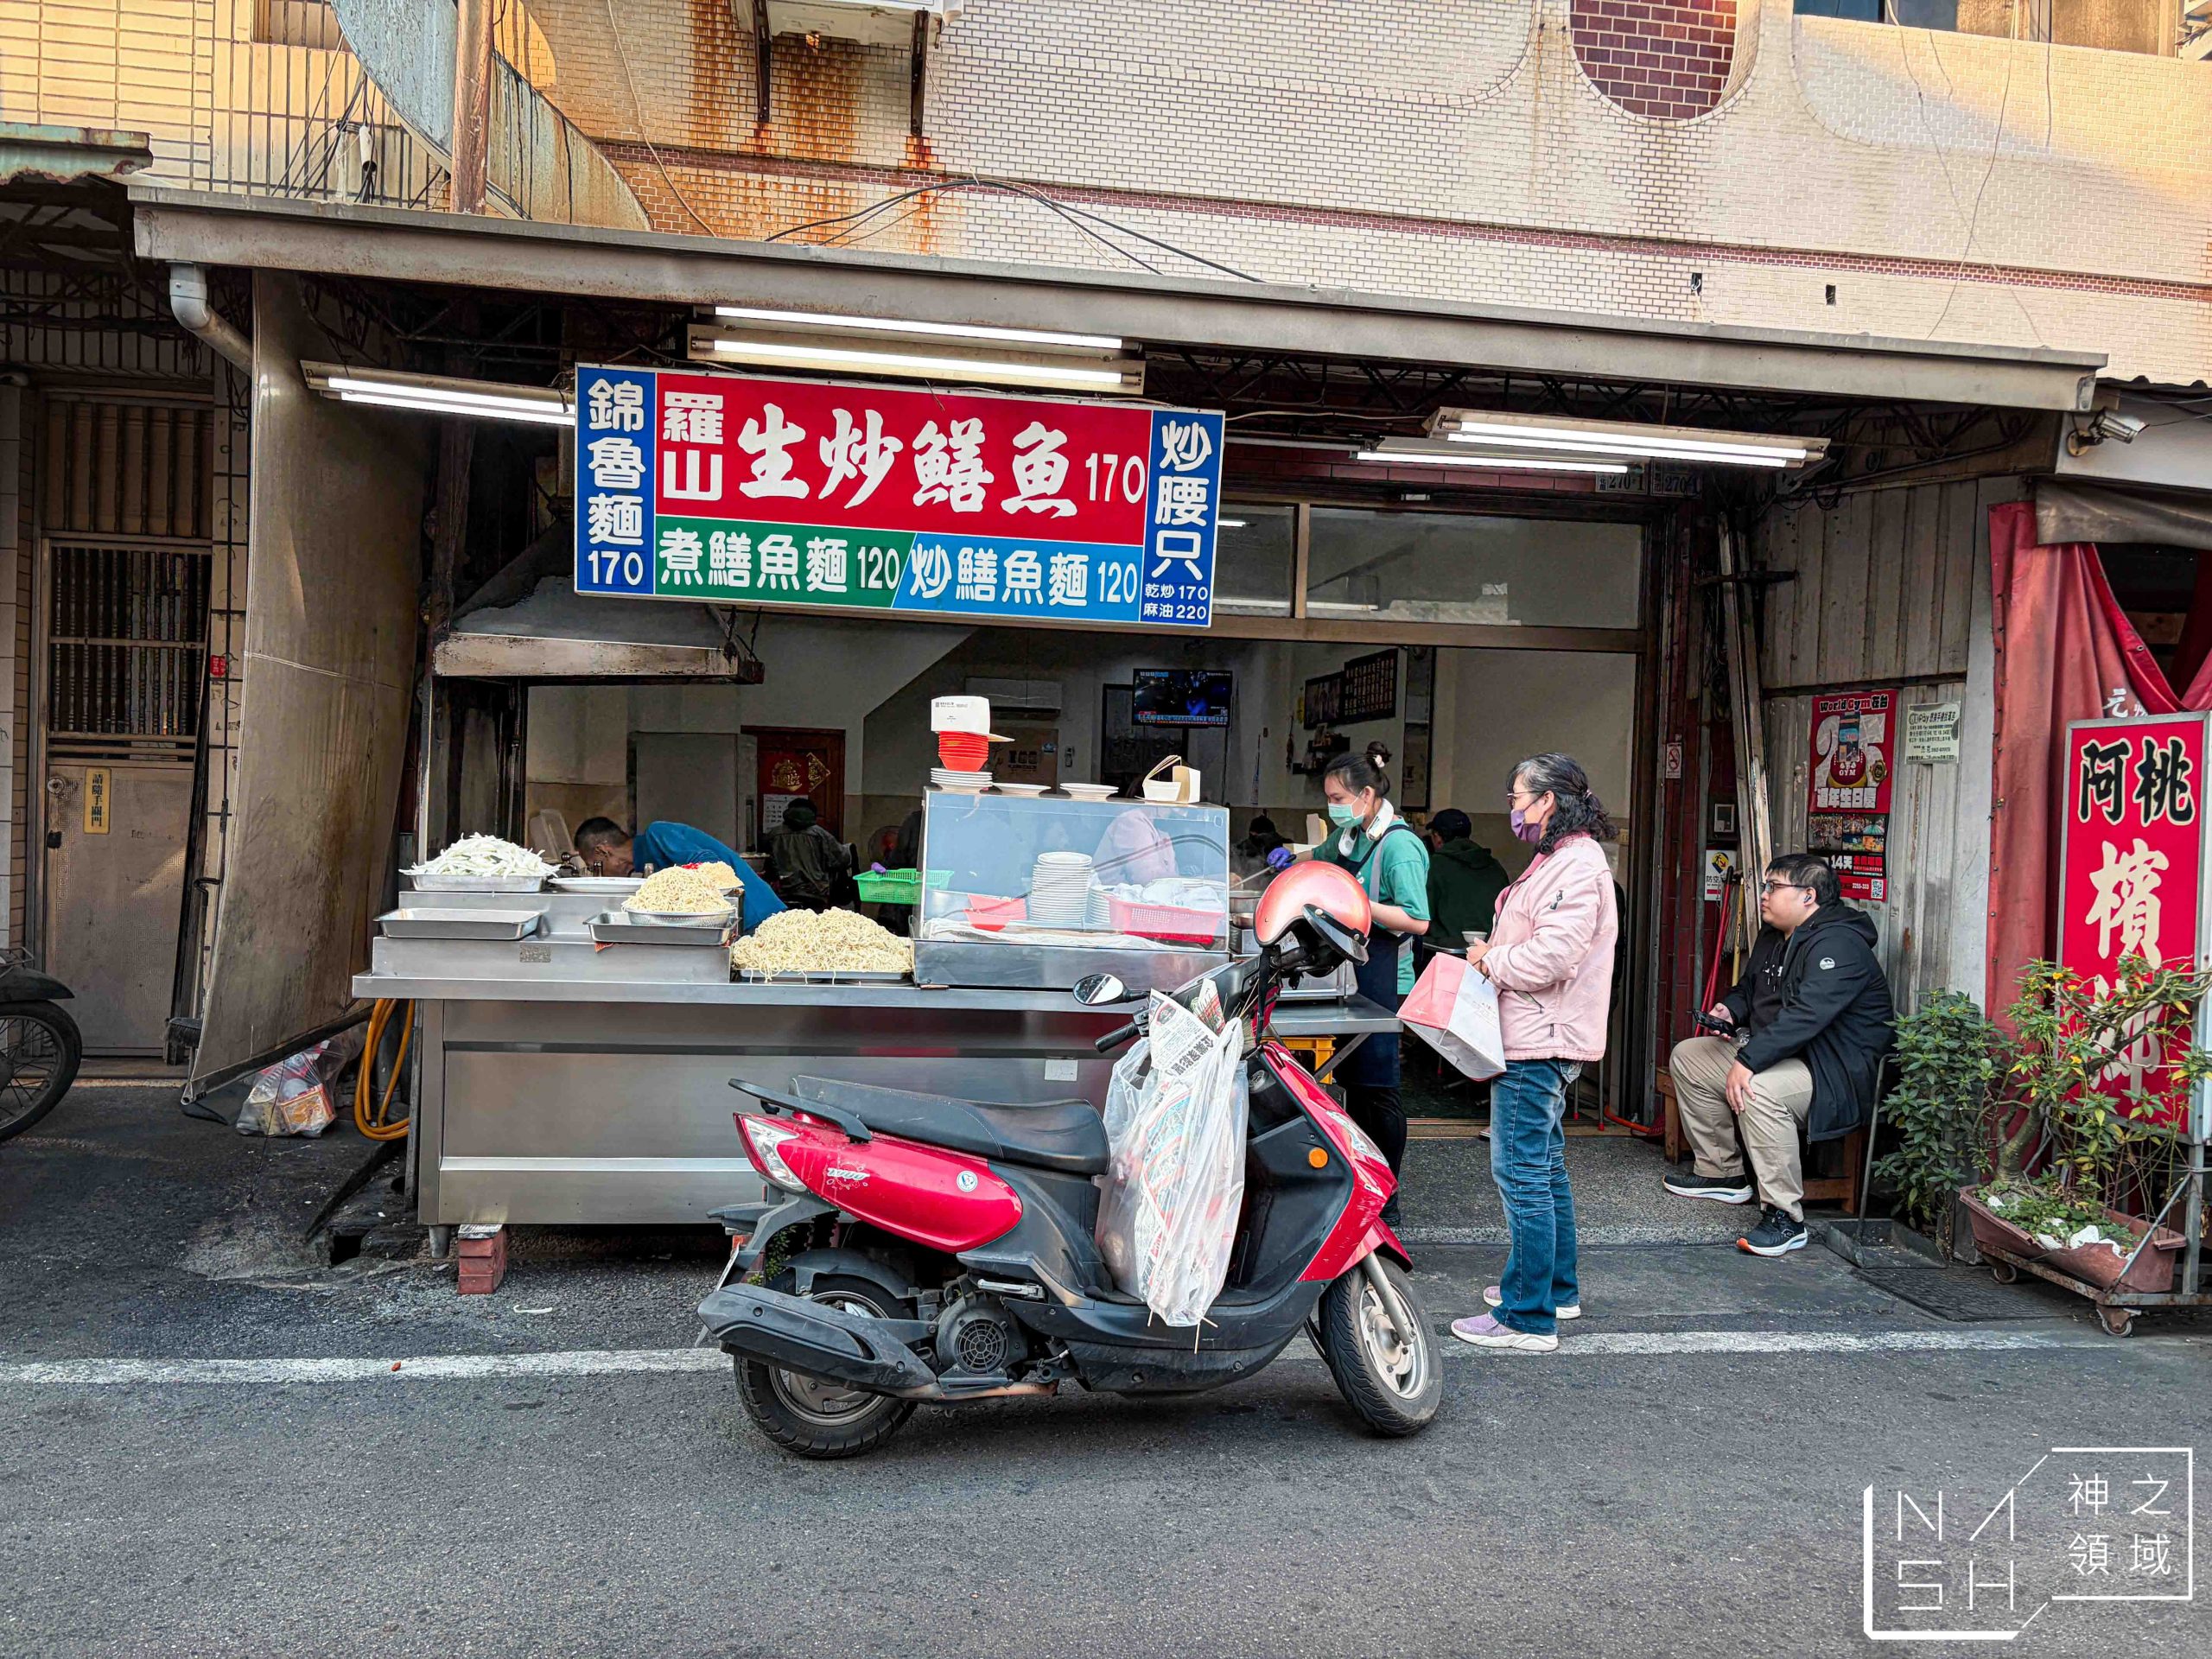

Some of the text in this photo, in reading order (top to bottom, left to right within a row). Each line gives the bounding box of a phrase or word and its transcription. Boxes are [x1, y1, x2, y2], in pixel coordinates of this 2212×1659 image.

[588, 378, 646, 545] 錦魯麵
[662, 391, 724, 501] 羅山
[737, 402, 1146, 519] 生炒鱔魚 170
[1151, 420, 1212, 581] 炒腰只
[588, 550, 644, 586] 170
[659, 526, 900, 593] 煮鱔魚麵 120
[912, 541, 1137, 607] 炒鱔魚麵 120
[1145, 583, 1209, 601] 乾炒 170
[1143, 602, 1207, 620] 麻油 220
[1820, 700, 1847, 712] World
[1847, 698, 1871, 710] Gym
[2077, 735, 2196, 826] 阿桃
